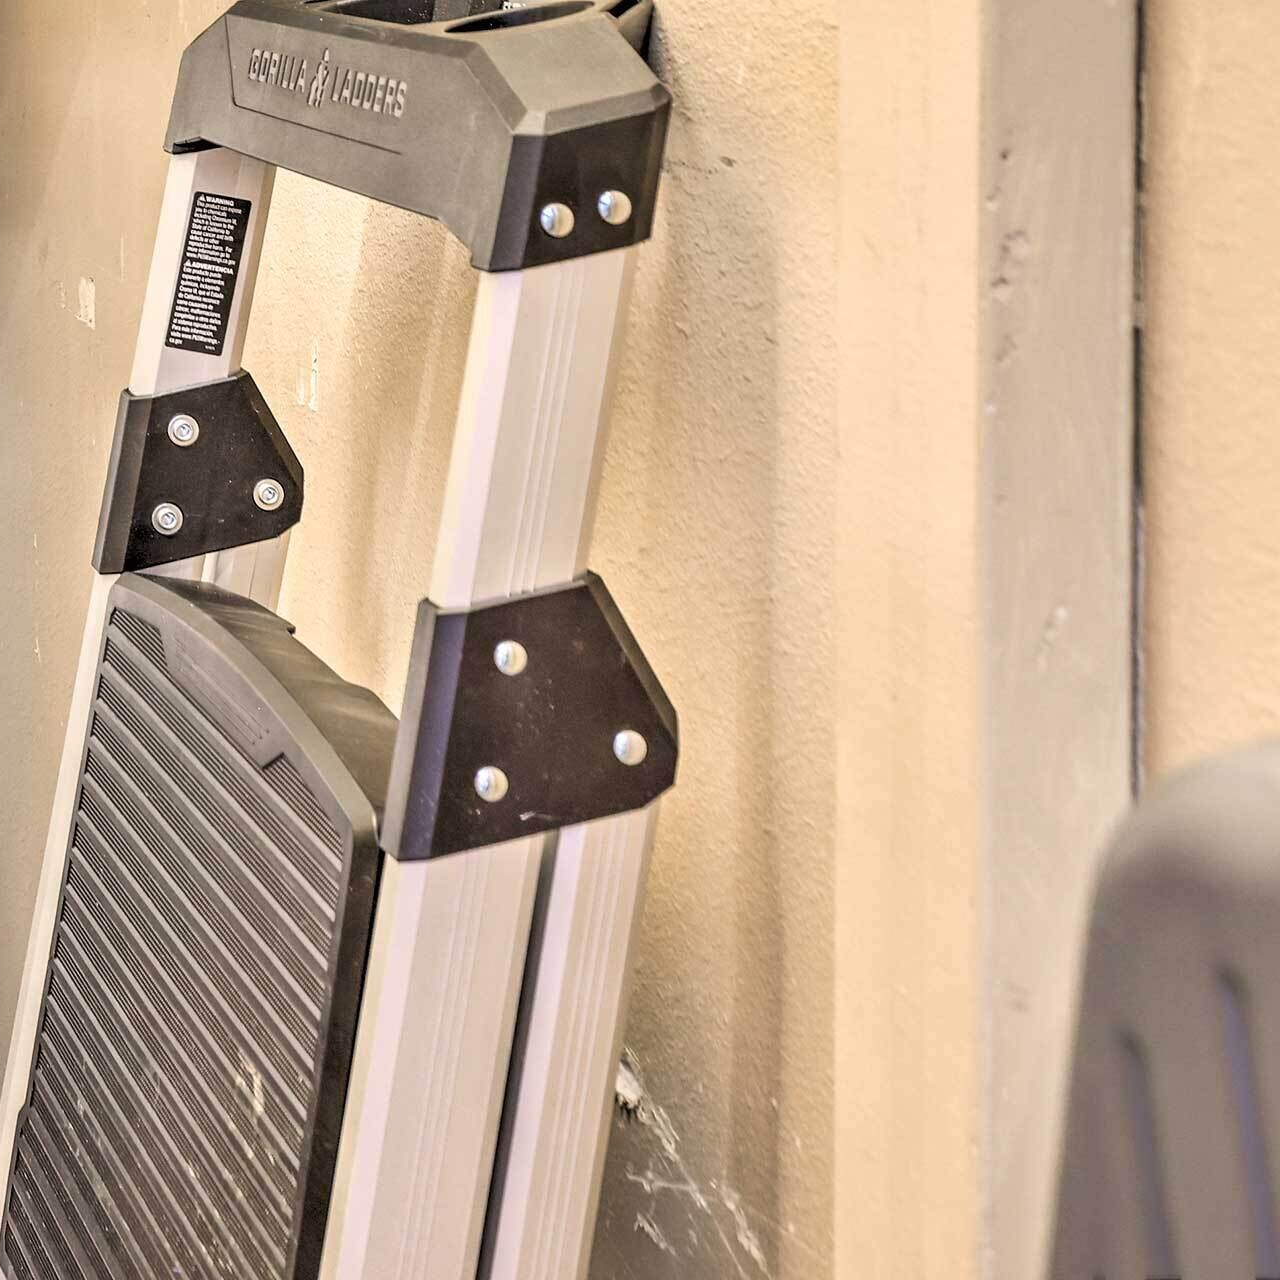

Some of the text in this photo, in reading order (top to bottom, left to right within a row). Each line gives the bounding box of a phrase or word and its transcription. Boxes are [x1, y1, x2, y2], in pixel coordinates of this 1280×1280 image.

[248, 48, 408, 118] GORILLA LADDERS
[204, 195, 234, 206] WARNING
[191, 261, 234, 274] ADVERTENCIA
